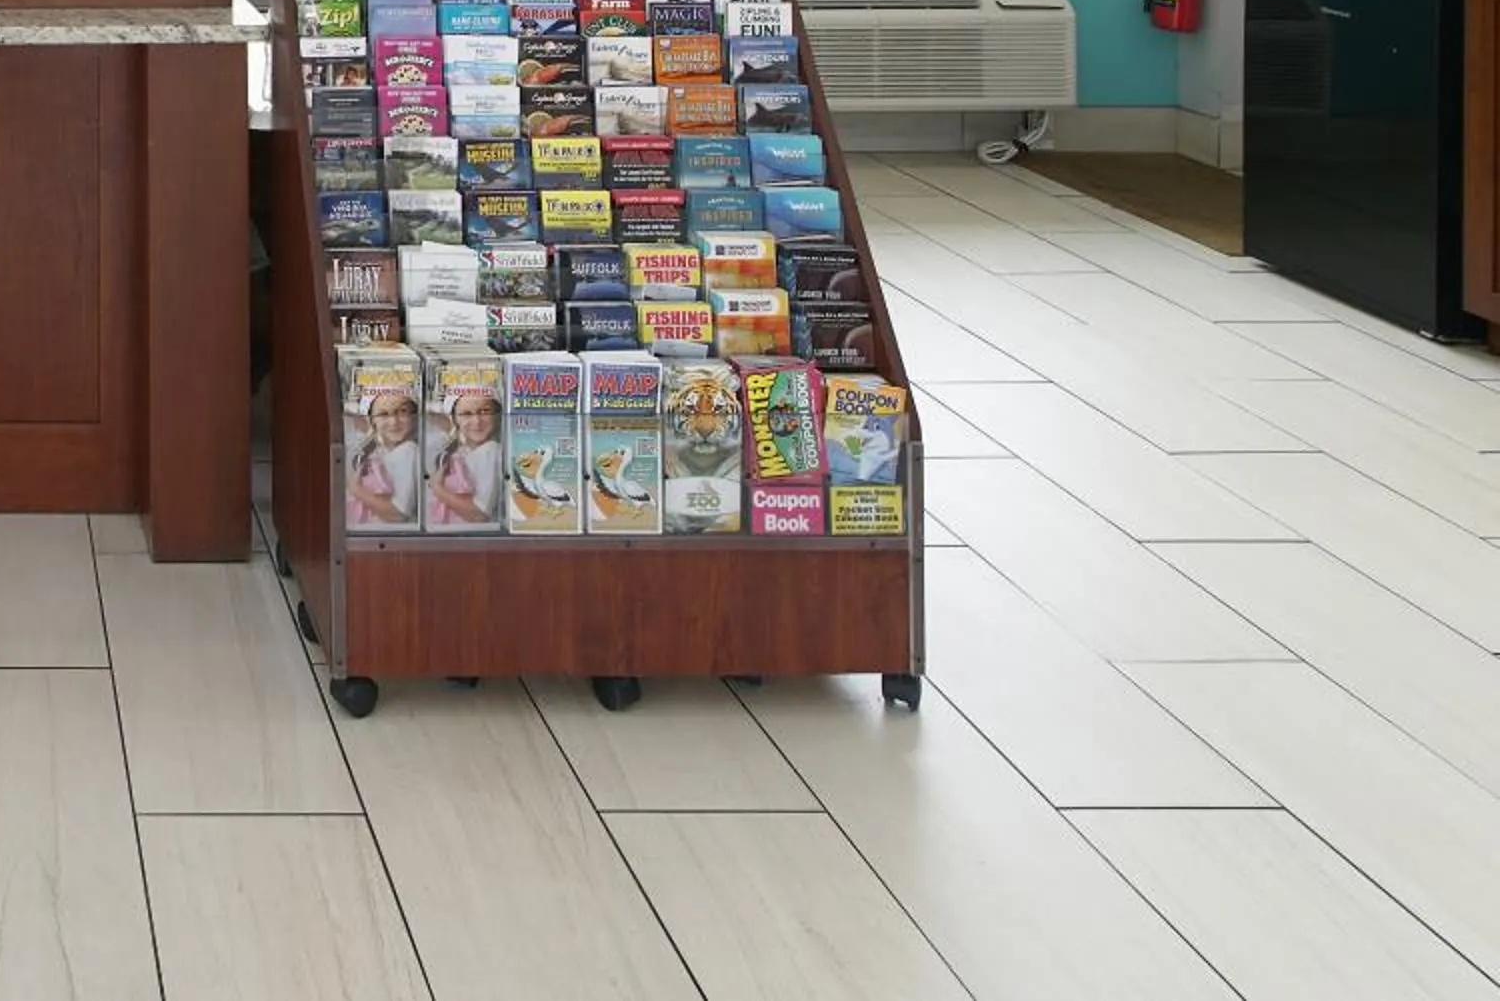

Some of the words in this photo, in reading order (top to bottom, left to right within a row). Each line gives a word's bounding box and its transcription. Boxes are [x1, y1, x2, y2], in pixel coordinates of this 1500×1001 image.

[319, 7, 359, 28] Zip!
[655, 6, 707, 21] MAGIC
[741, 24, 782, 37] FUN!
[467, 150, 515, 163] MUSEUM
[478, 202, 528, 216] MUSEUM
[571, 262, 620, 275] SUFFOLK
[636, 255, 697, 269] FISHING
[333, 258, 382, 291] LURAY
[644, 270, 691, 284] TRIPS
[581, 319, 632, 331] SUFFOLK
[646, 310, 710, 325] FISHING
[654, 326, 703, 340] TRIPS
[513, 372, 579, 396] MAP
[592, 372, 659, 396] MAP
[796, 372, 809, 409] BOOK
[835, 388, 899, 410] COUPON
[835, 400, 876, 415] BOOK
[746, 373, 793, 479] MONSTER
[799, 410, 820, 469] COUPON
[686, 496, 721, 508] ZOO
[752, 490, 821, 514] Coupon
[763, 514, 811, 532] Book
